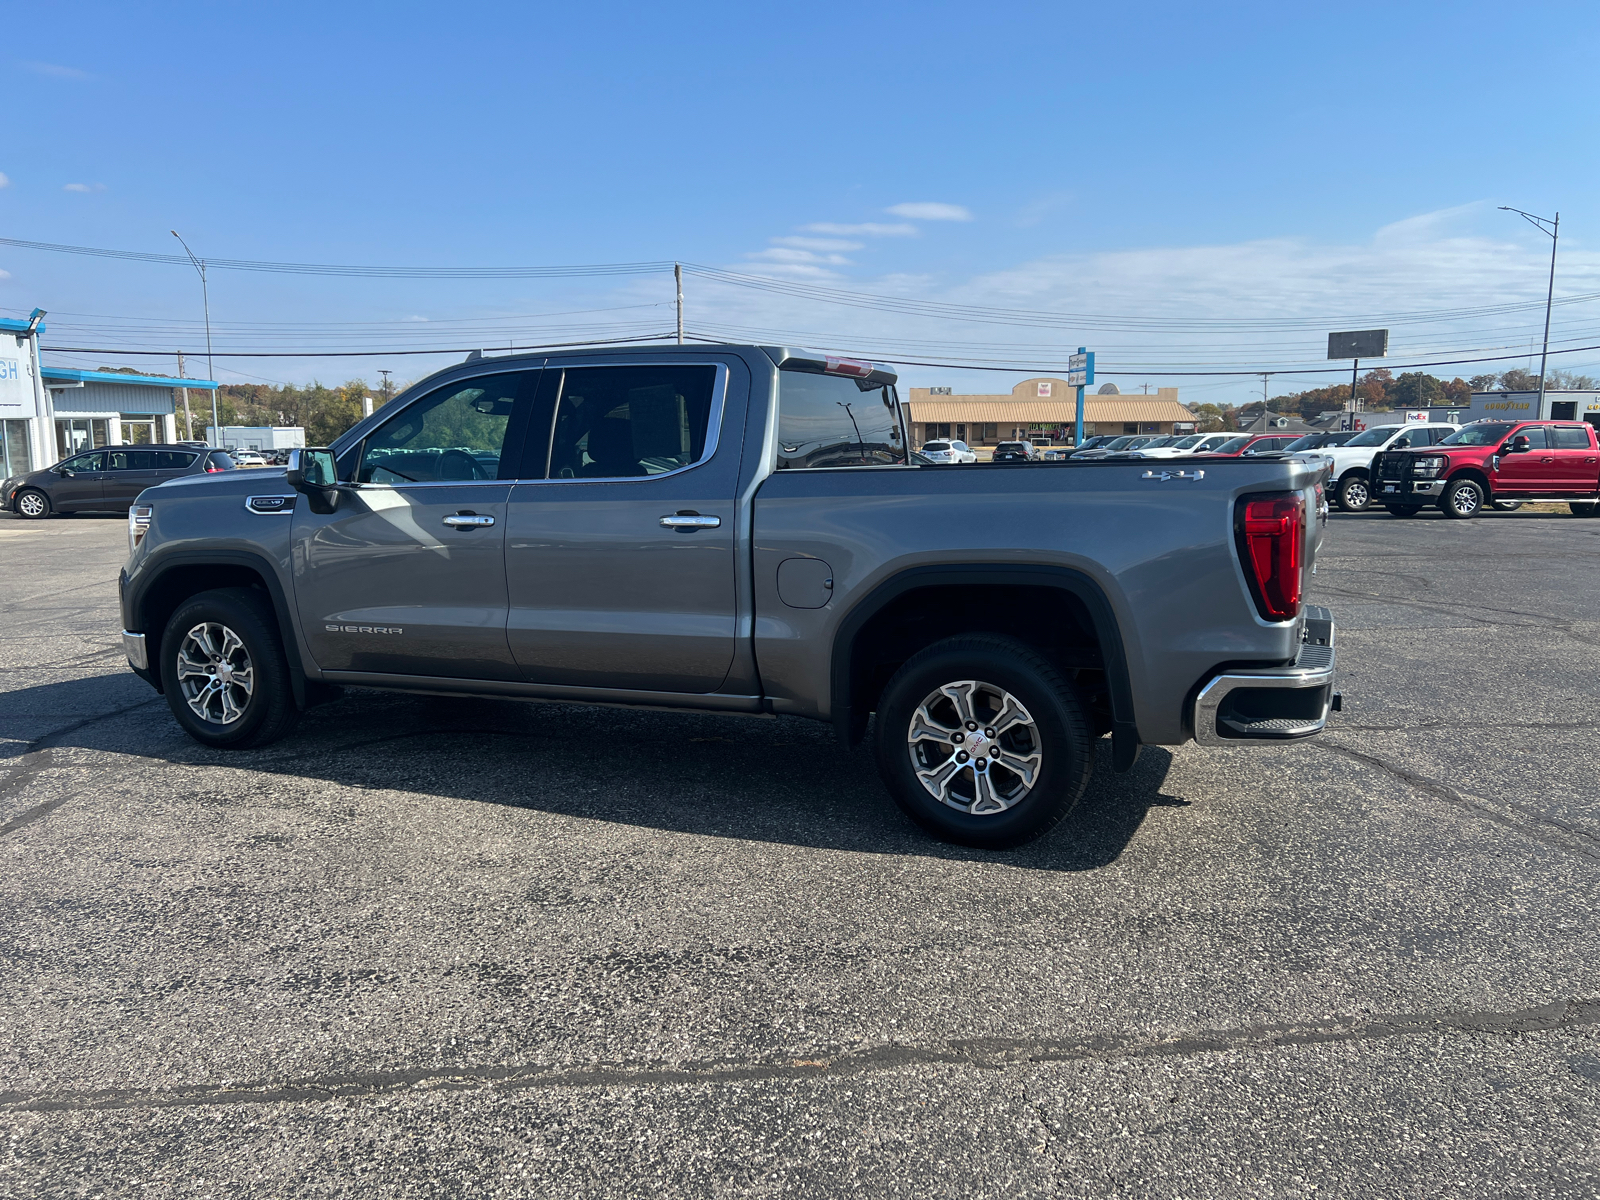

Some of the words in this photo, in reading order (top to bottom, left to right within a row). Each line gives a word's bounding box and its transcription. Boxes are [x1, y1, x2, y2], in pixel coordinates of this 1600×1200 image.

[1484, 401, 1530, 411] GOODYEAR
[1407, 413, 1426, 421] FedEx
[325, 624, 403, 635] SIERRA
[970, 736, 983, 753] GMC
